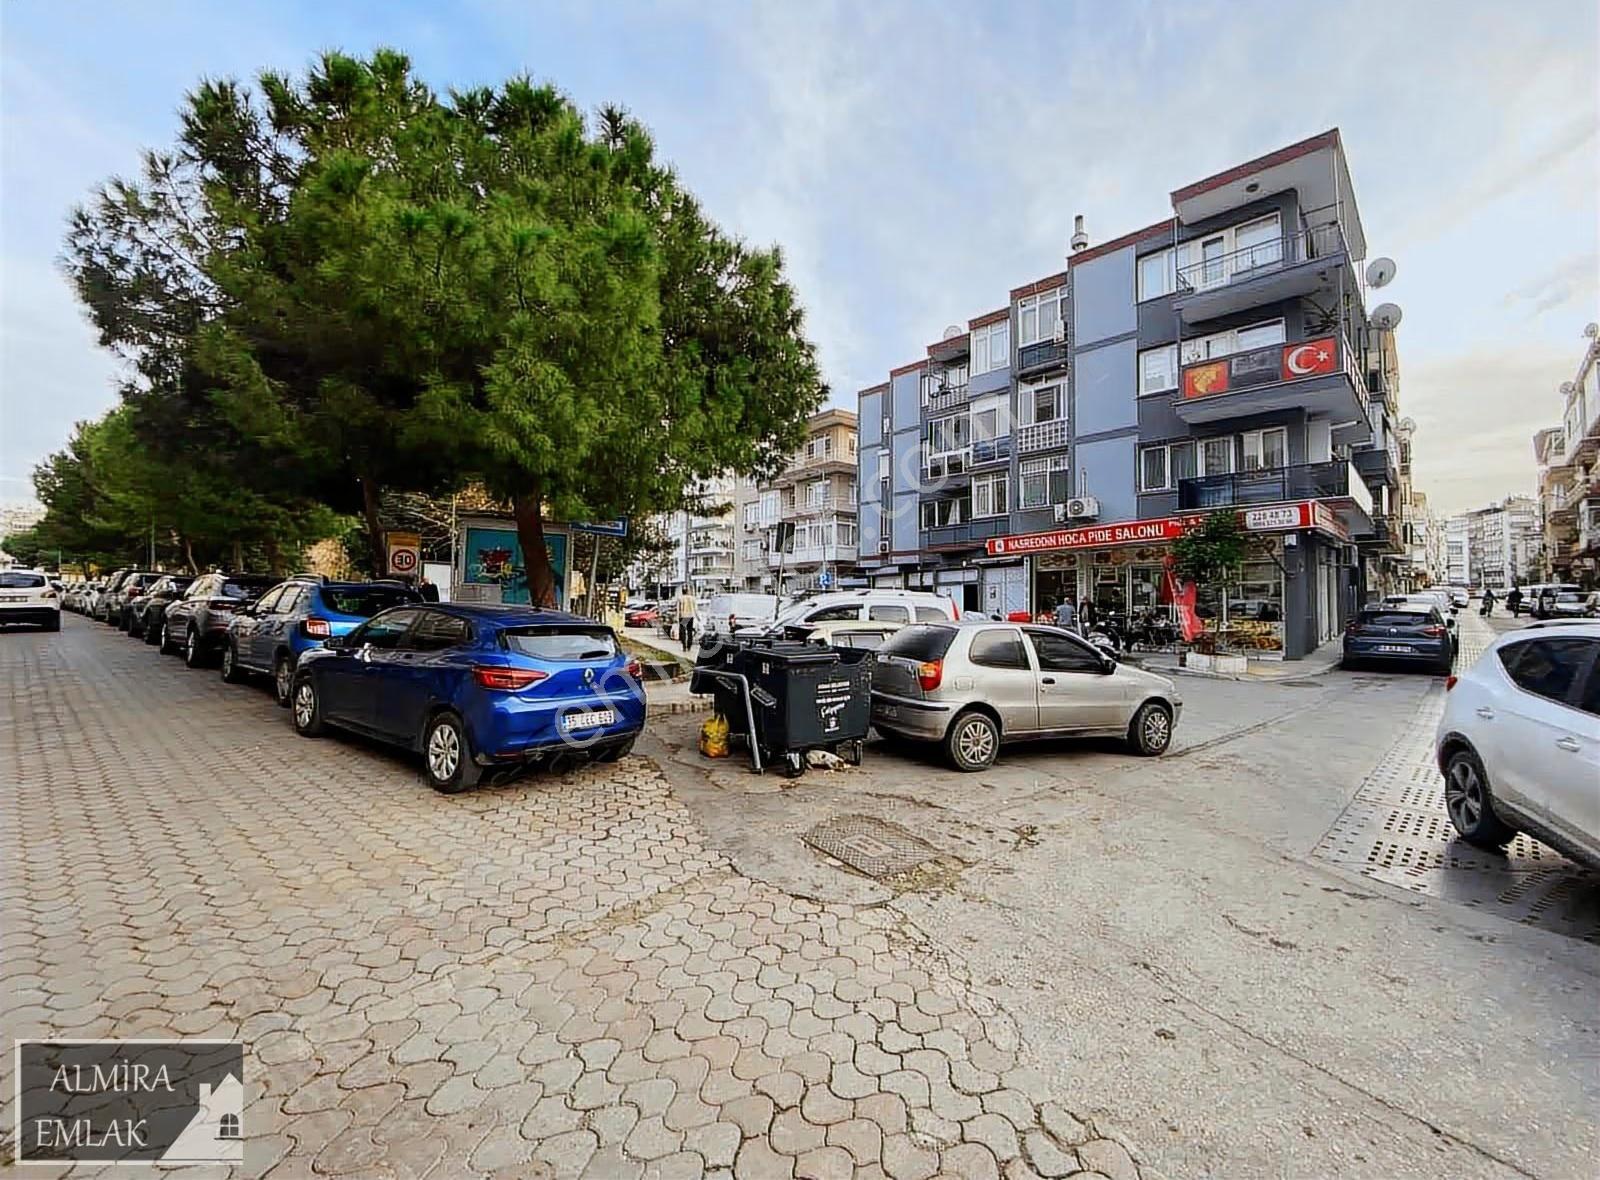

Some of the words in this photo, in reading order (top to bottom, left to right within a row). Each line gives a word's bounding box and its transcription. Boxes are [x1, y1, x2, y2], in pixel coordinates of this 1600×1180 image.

[1058, 533, 1087, 546] HOCA
[1115, 523, 1165, 541] SALONU
[396, 554, 412, 567] 30
